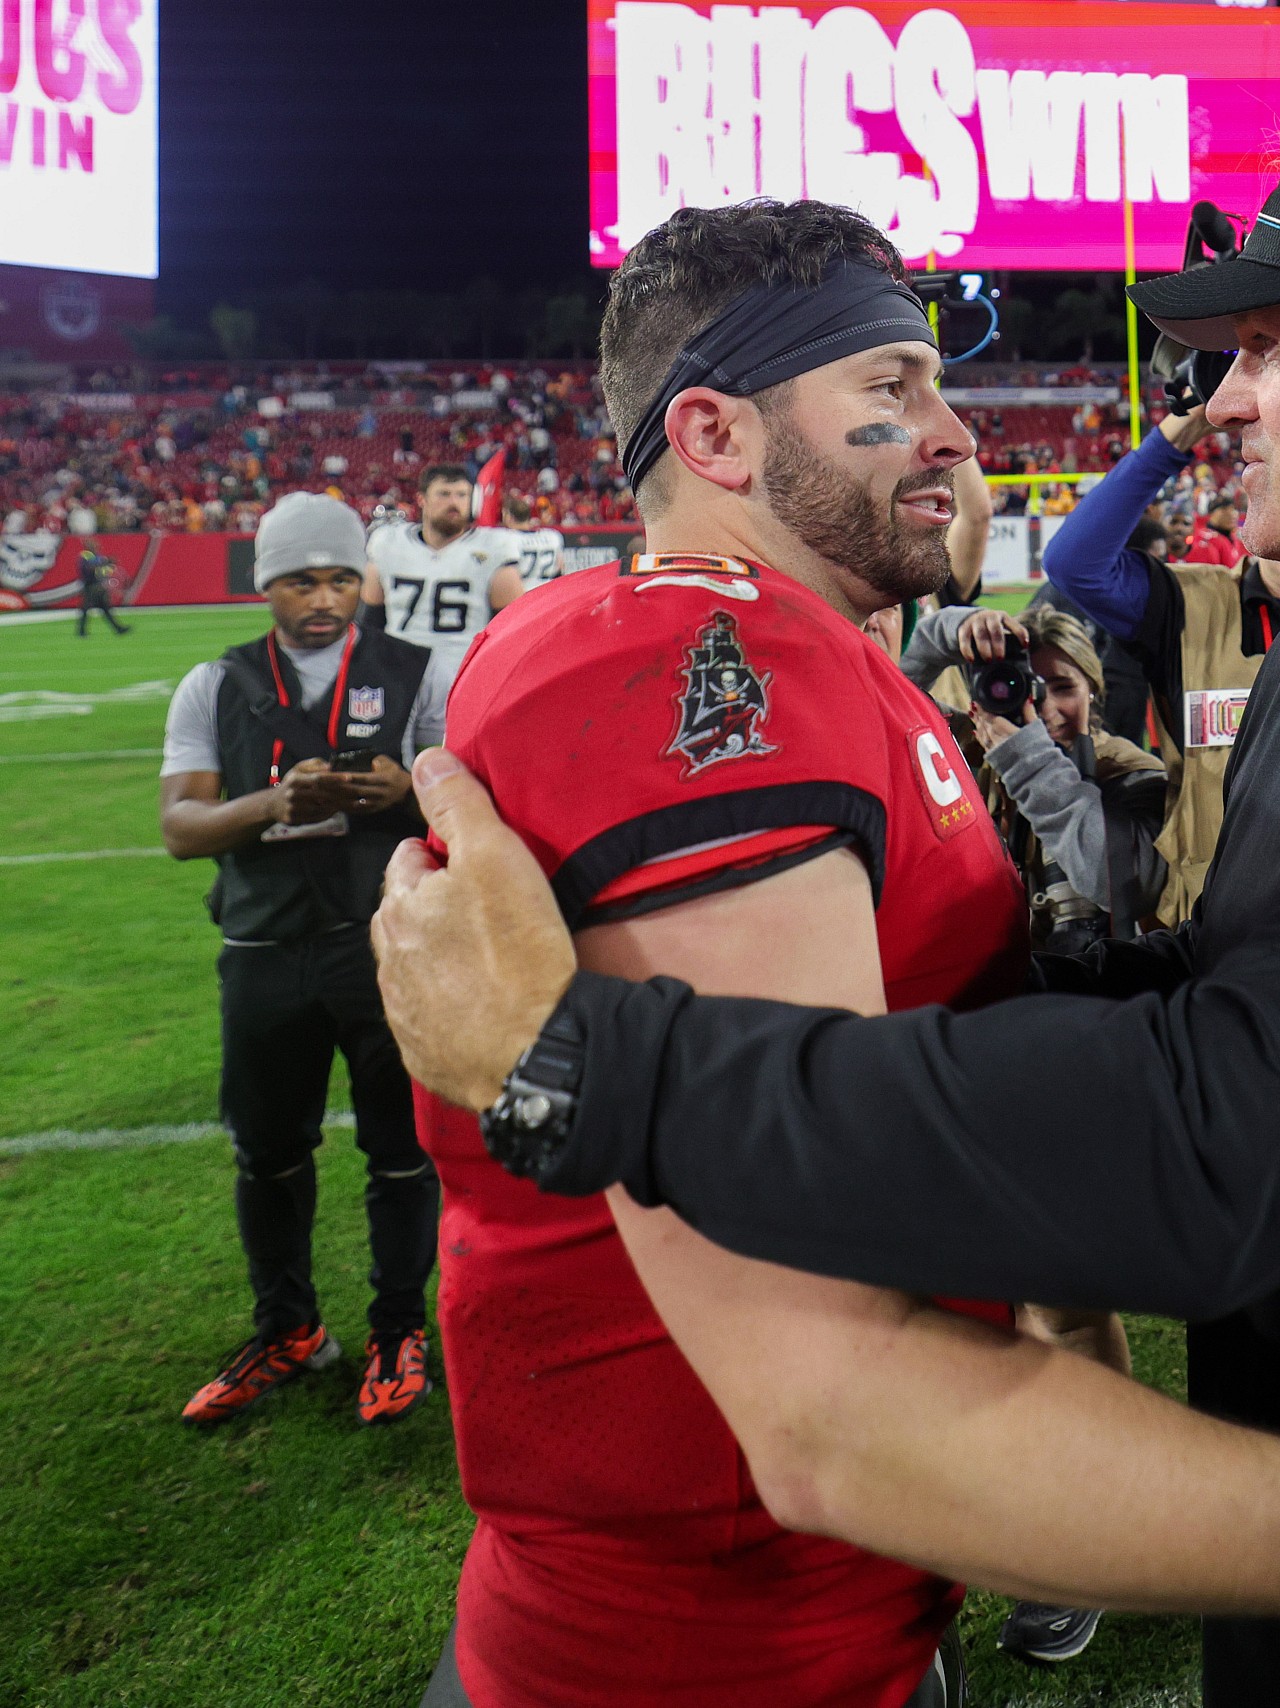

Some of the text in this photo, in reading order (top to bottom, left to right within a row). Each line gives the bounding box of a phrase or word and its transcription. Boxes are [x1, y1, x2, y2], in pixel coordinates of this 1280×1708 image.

[977, 69, 1190, 202] WIN
[394, 577, 470, 633] 76
[916, 731, 963, 807] C
